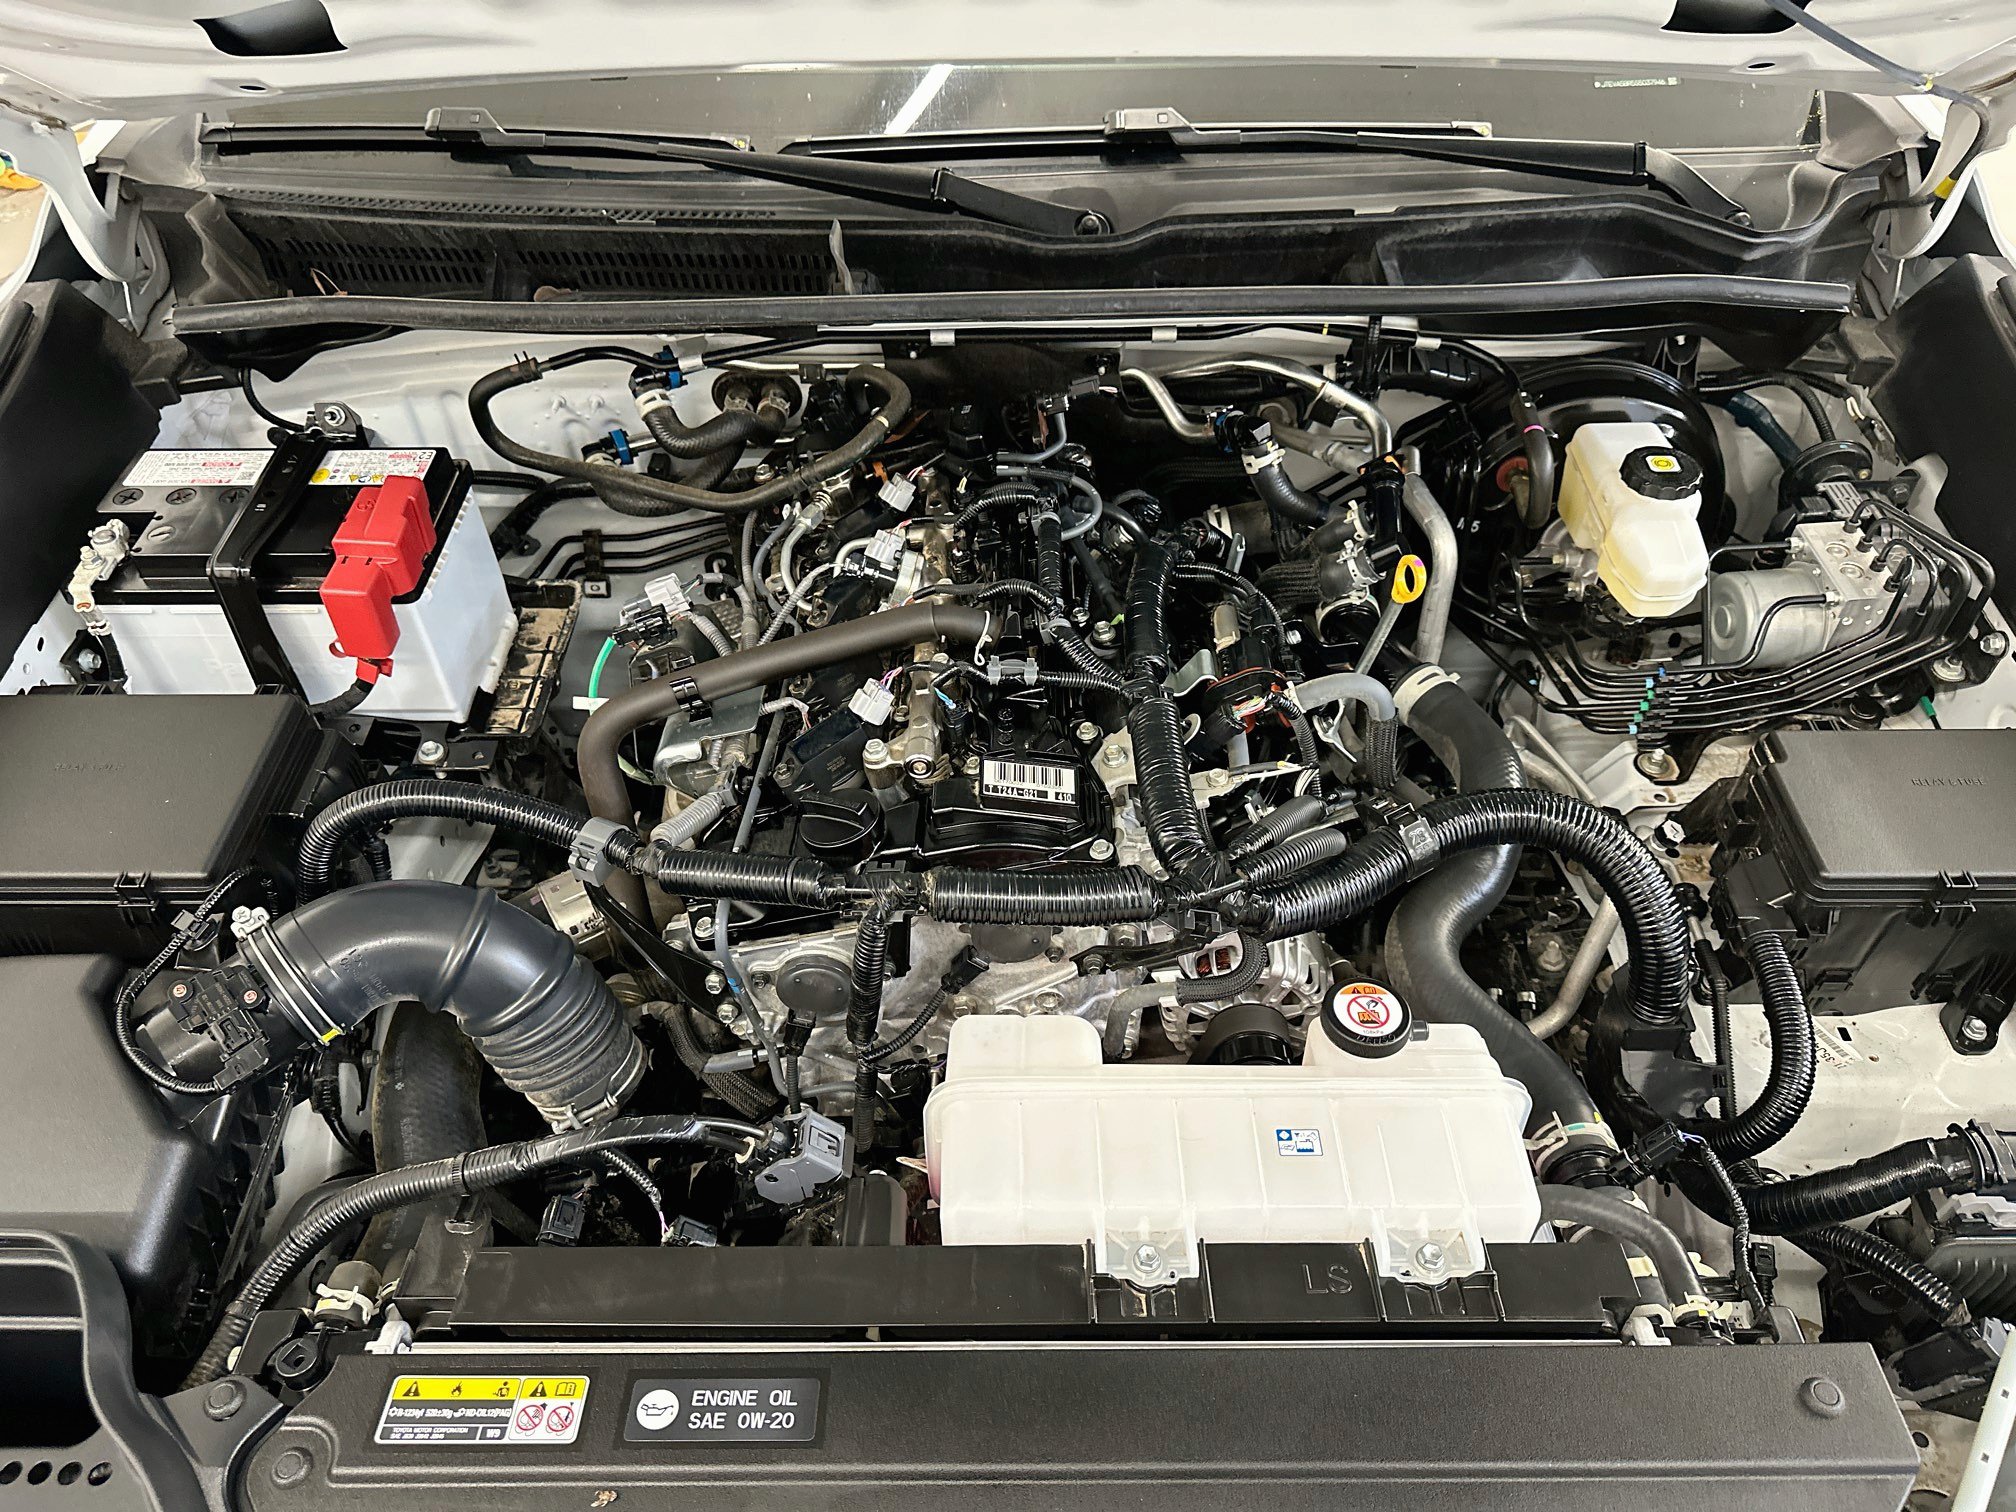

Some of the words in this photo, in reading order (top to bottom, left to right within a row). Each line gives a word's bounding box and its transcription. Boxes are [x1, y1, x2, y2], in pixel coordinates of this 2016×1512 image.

[418, 451, 434, 460] E2
[997, 785, 1038, 798] T24A-G21
[1057, 793, 1072, 802] 410
[1302, 1264, 1353, 1294] LS
[691, 1389, 759, 1407] ENGINE
[769, 1389, 798, 1407] OIL
[687, 1411, 727, 1430] SAE
[737, 1411, 795, 1430] 0W-20
